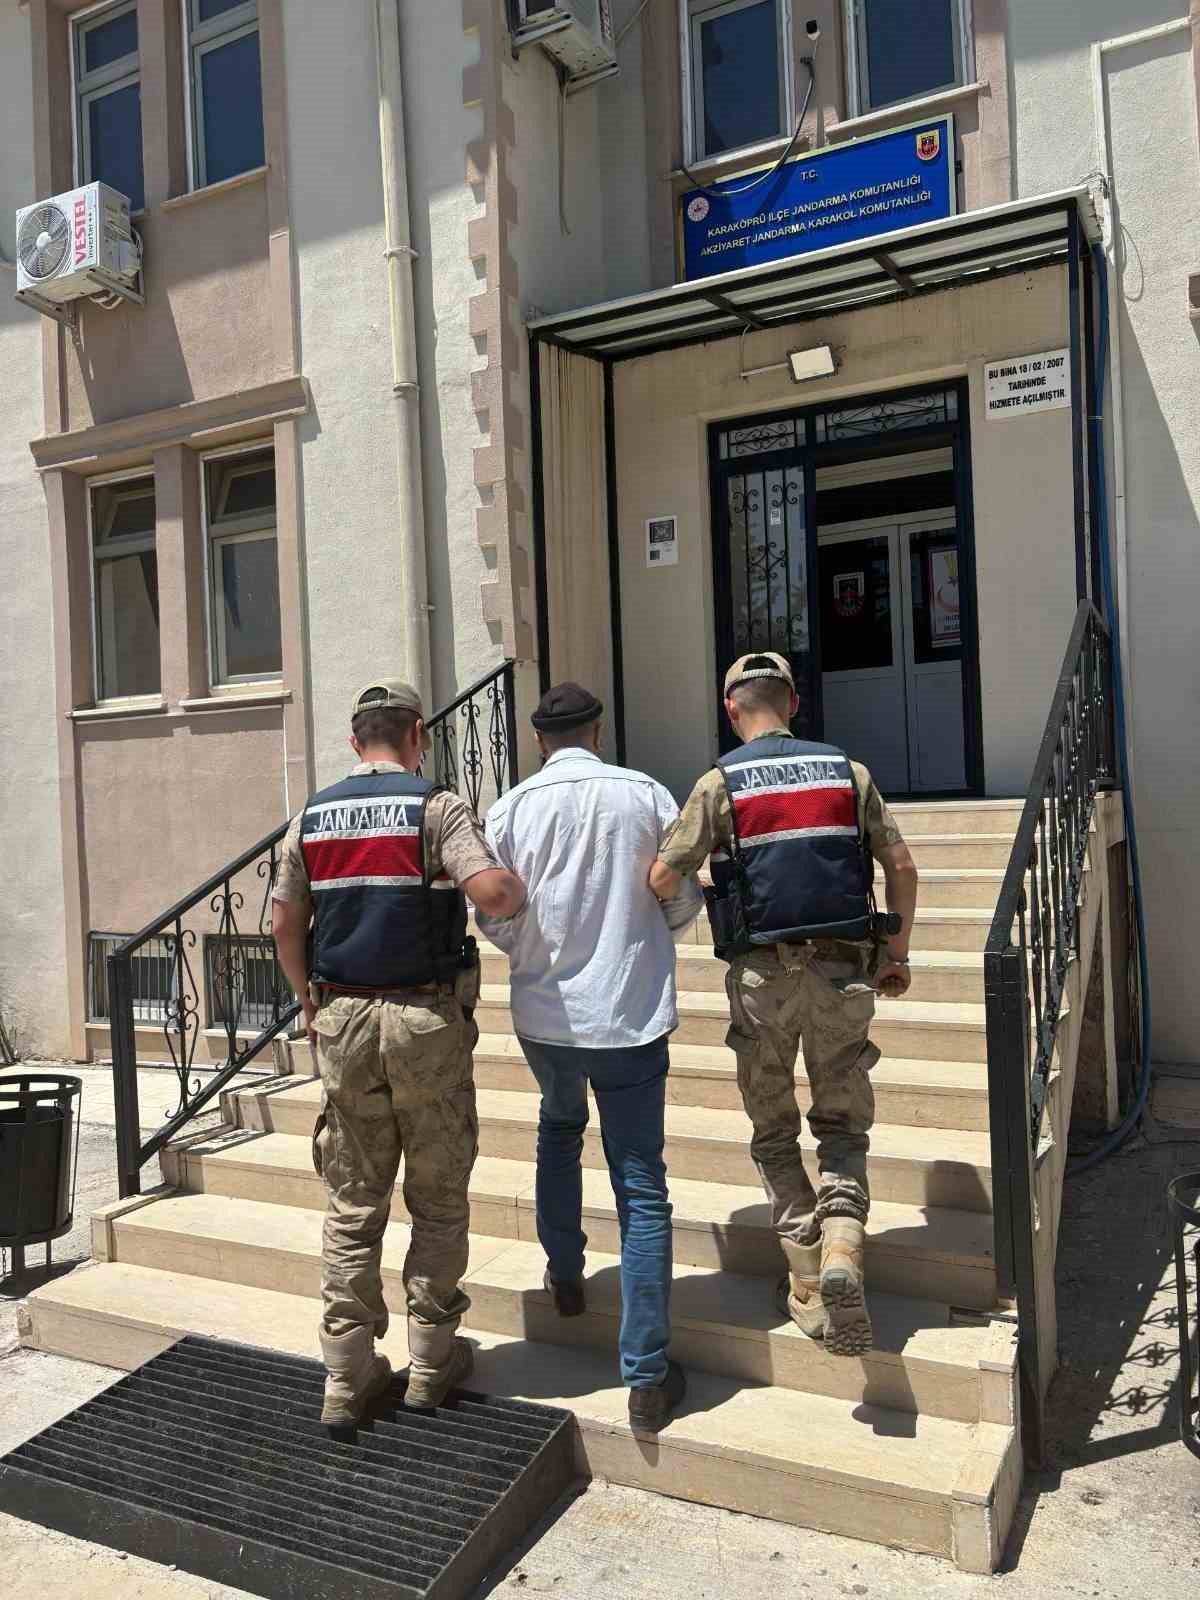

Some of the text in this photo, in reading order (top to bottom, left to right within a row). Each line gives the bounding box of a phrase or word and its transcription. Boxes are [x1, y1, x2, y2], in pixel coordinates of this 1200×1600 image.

[801, 169, 819, 181] T.C.
[708, 212, 766, 238] KARAKÖPRÜ
[792, 194, 848, 216] JANDARMA
[850, 174, 921, 201] KOMUTANLIĞI
[74, 194, 86, 265] VESTEL
[700, 190, 931, 256] AKZİYARET JANDARMA KARAKOL KOMUTANLIĞI
[988, 369, 998, 380] BU
[1032, 360, 1042, 370] 02
[1047, 358, 1064, 368] 2007
[1008, 376, 1047, 391] TARİHİNDE
[1022, 388, 1065, 406] AÇILMIŞTIR
[740, 760, 840, 790] JANDARMA
[313, 804, 409, 832] JANDARMA
